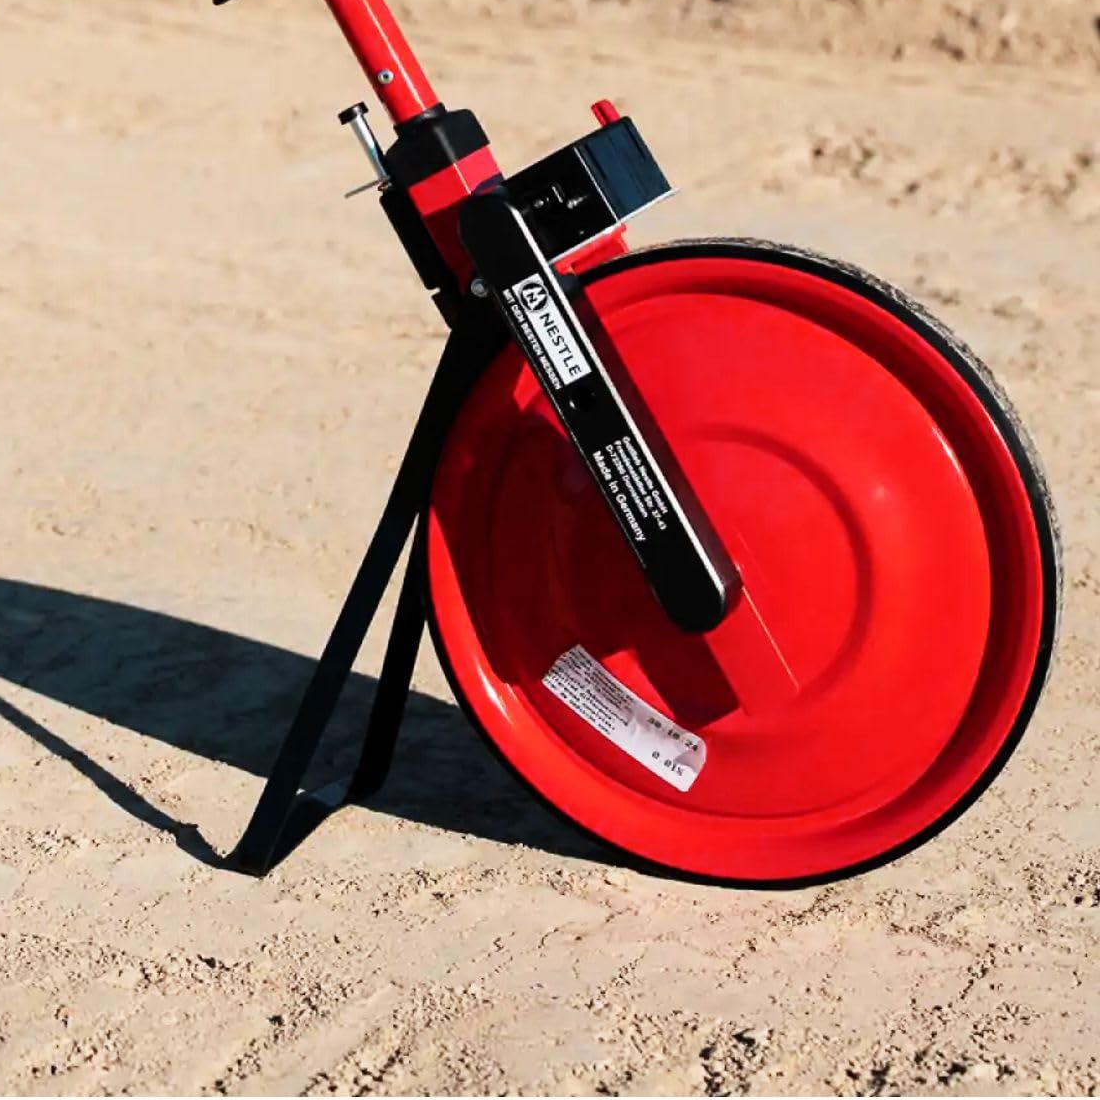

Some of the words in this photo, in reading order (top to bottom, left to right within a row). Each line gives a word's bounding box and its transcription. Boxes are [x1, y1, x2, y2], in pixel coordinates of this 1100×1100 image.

[540, 312, 581, 376] NESTLE
[592, 450, 612, 481] Made
[608, 480, 619, 494] in
[615, 494, 646, 540] Germany
